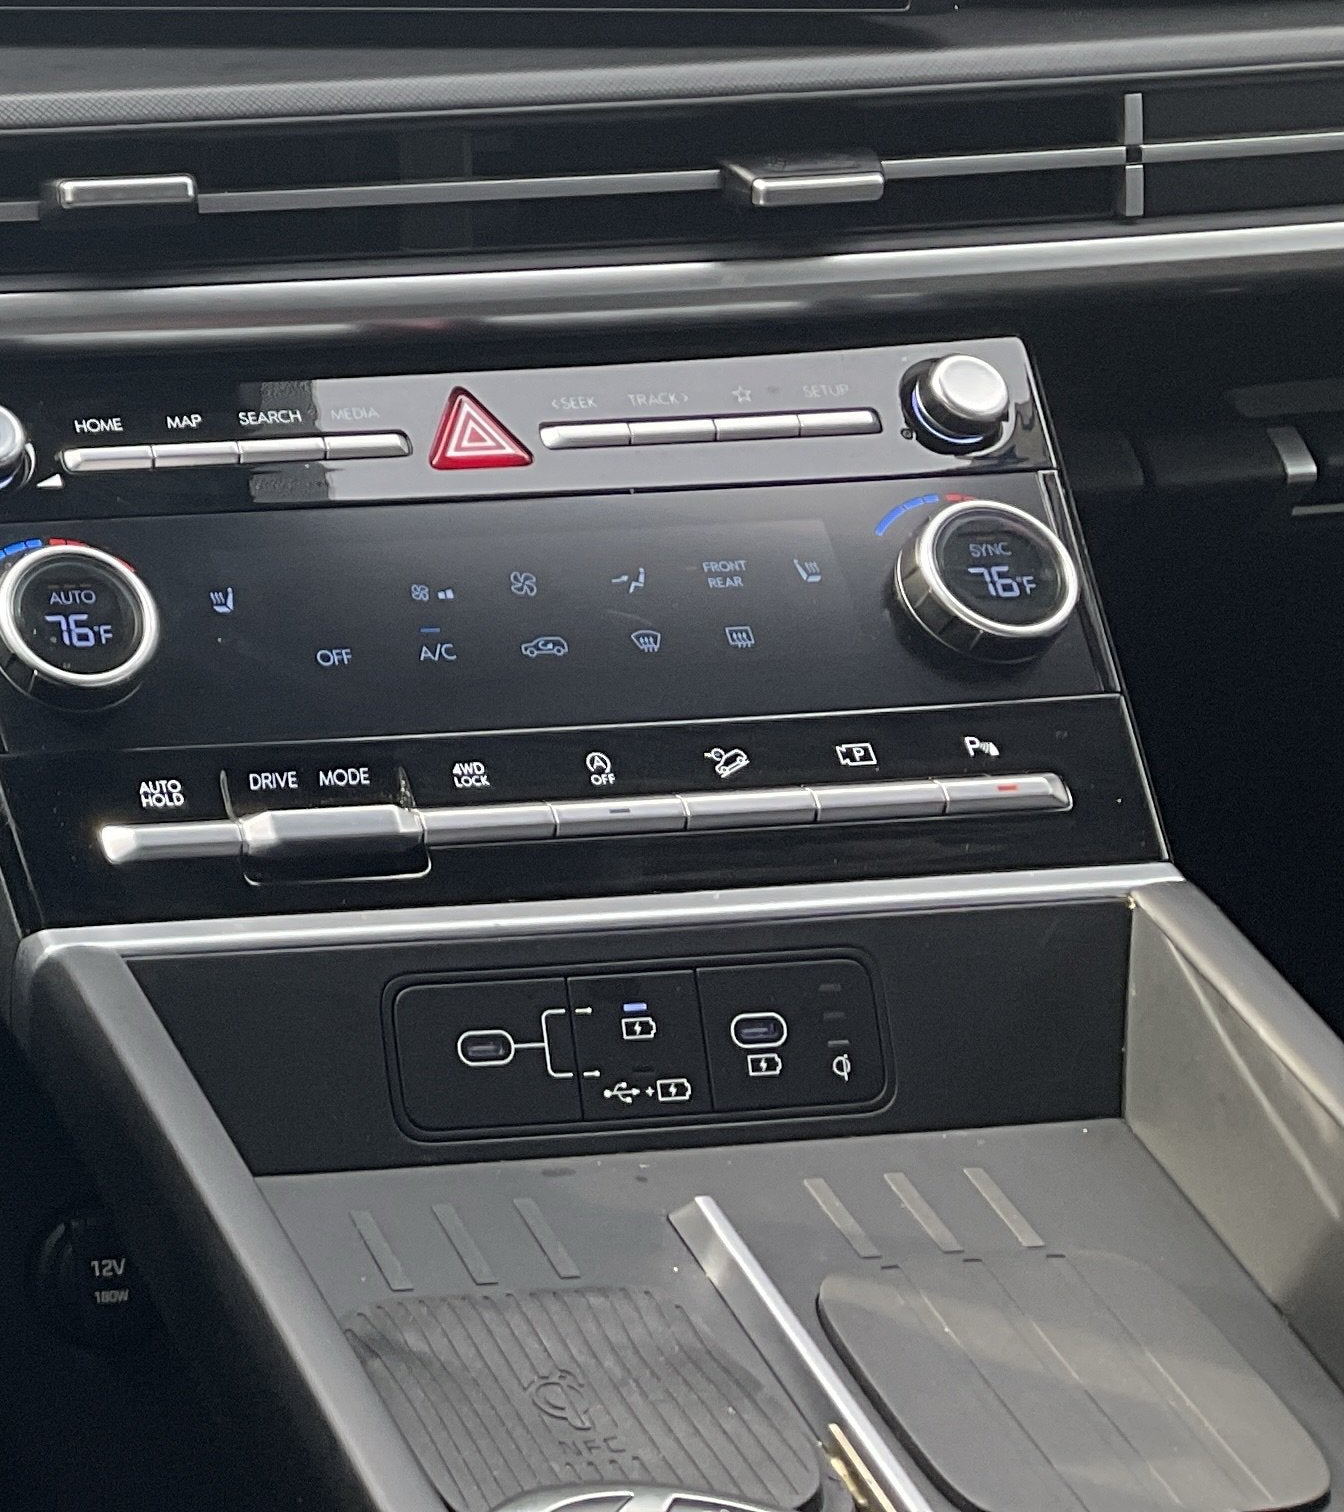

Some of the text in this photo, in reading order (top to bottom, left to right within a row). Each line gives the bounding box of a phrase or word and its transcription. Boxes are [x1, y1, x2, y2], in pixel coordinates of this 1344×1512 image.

[802, 381, 850, 398] SETUP
[237, 409, 303, 427] SEARCH
[329, 405, 381, 421] MEDIA
[73, 416, 125, 434] HOME
[166, 413, 203, 430] MAP
[969, 542, 1012, 558] SYNC
[702, 559, 747, 574] FRONT
[707, 575, 744, 589] REAR
[49, 589, 96, 605] AUTO
[316, 648, 353, 667] OFF
[419, 642, 457, 662] A/C
[452, 762, 485, 776] 4WD
[139, 780, 182, 795] AUTO
[249, 768, 371, 791] DRIVE MODE
[453, 773, 491, 789] LOCK
[591, 773, 616, 786] OFF
[141, 792, 186, 809] HOLD
[91, 1258, 126, 1277] 12V
